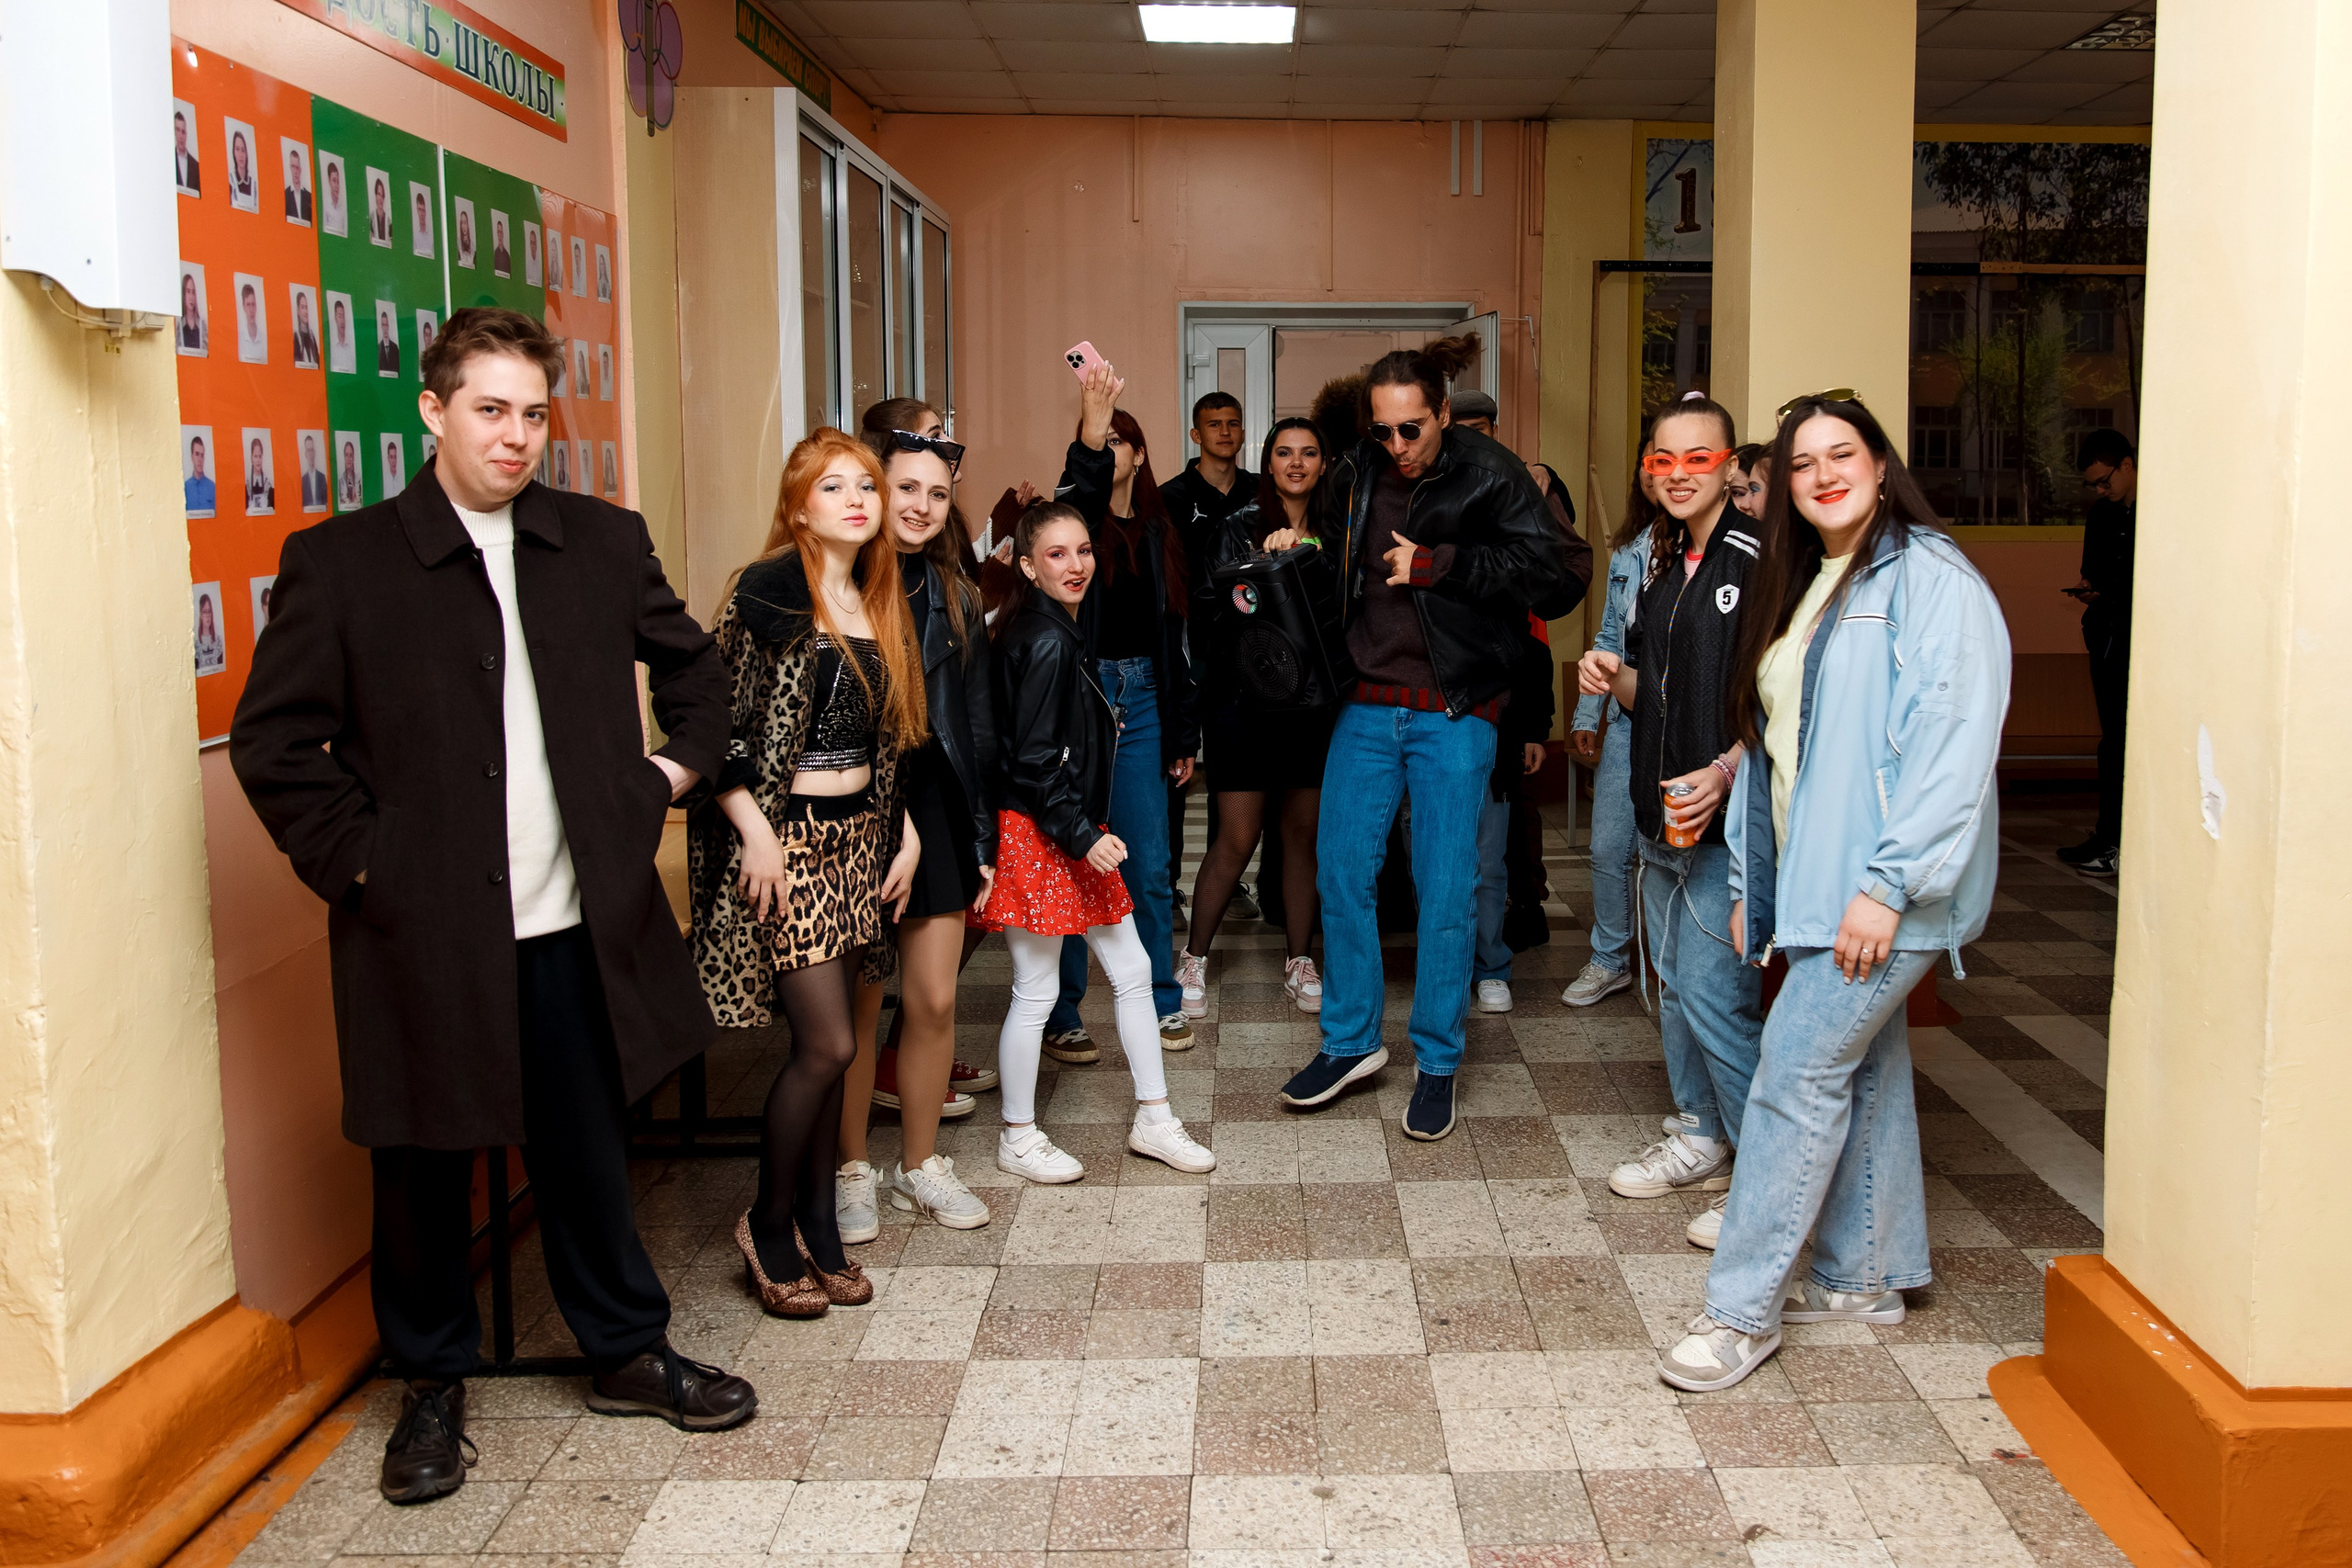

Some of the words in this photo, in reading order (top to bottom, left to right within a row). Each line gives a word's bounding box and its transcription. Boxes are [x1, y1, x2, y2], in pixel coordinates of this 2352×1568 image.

[739, 2, 755, 43] МЫ
[327, 0, 440, 58] СТЬ
[453, 20, 556, 121] ШКОЛЫ
[1674, 168, 1713, 234] 1
[1723, 591, 1731, 605] 5
